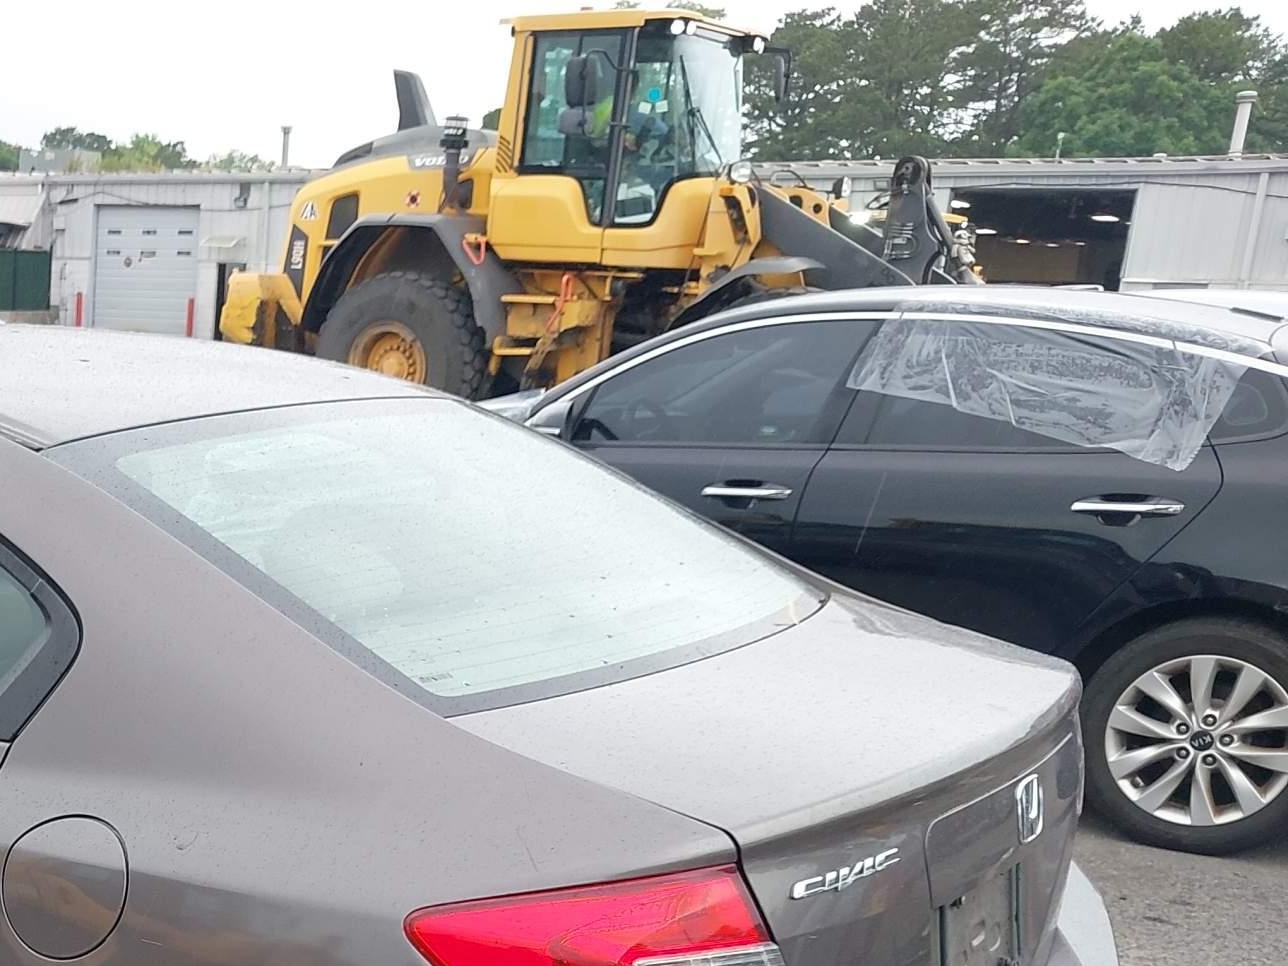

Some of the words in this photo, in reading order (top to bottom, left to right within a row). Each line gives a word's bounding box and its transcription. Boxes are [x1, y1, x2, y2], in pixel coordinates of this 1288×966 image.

[415, 154, 469, 167] VOLO
[1191, 734, 1212, 748] KIA
[793, 847, 901, 899] CIVIC
